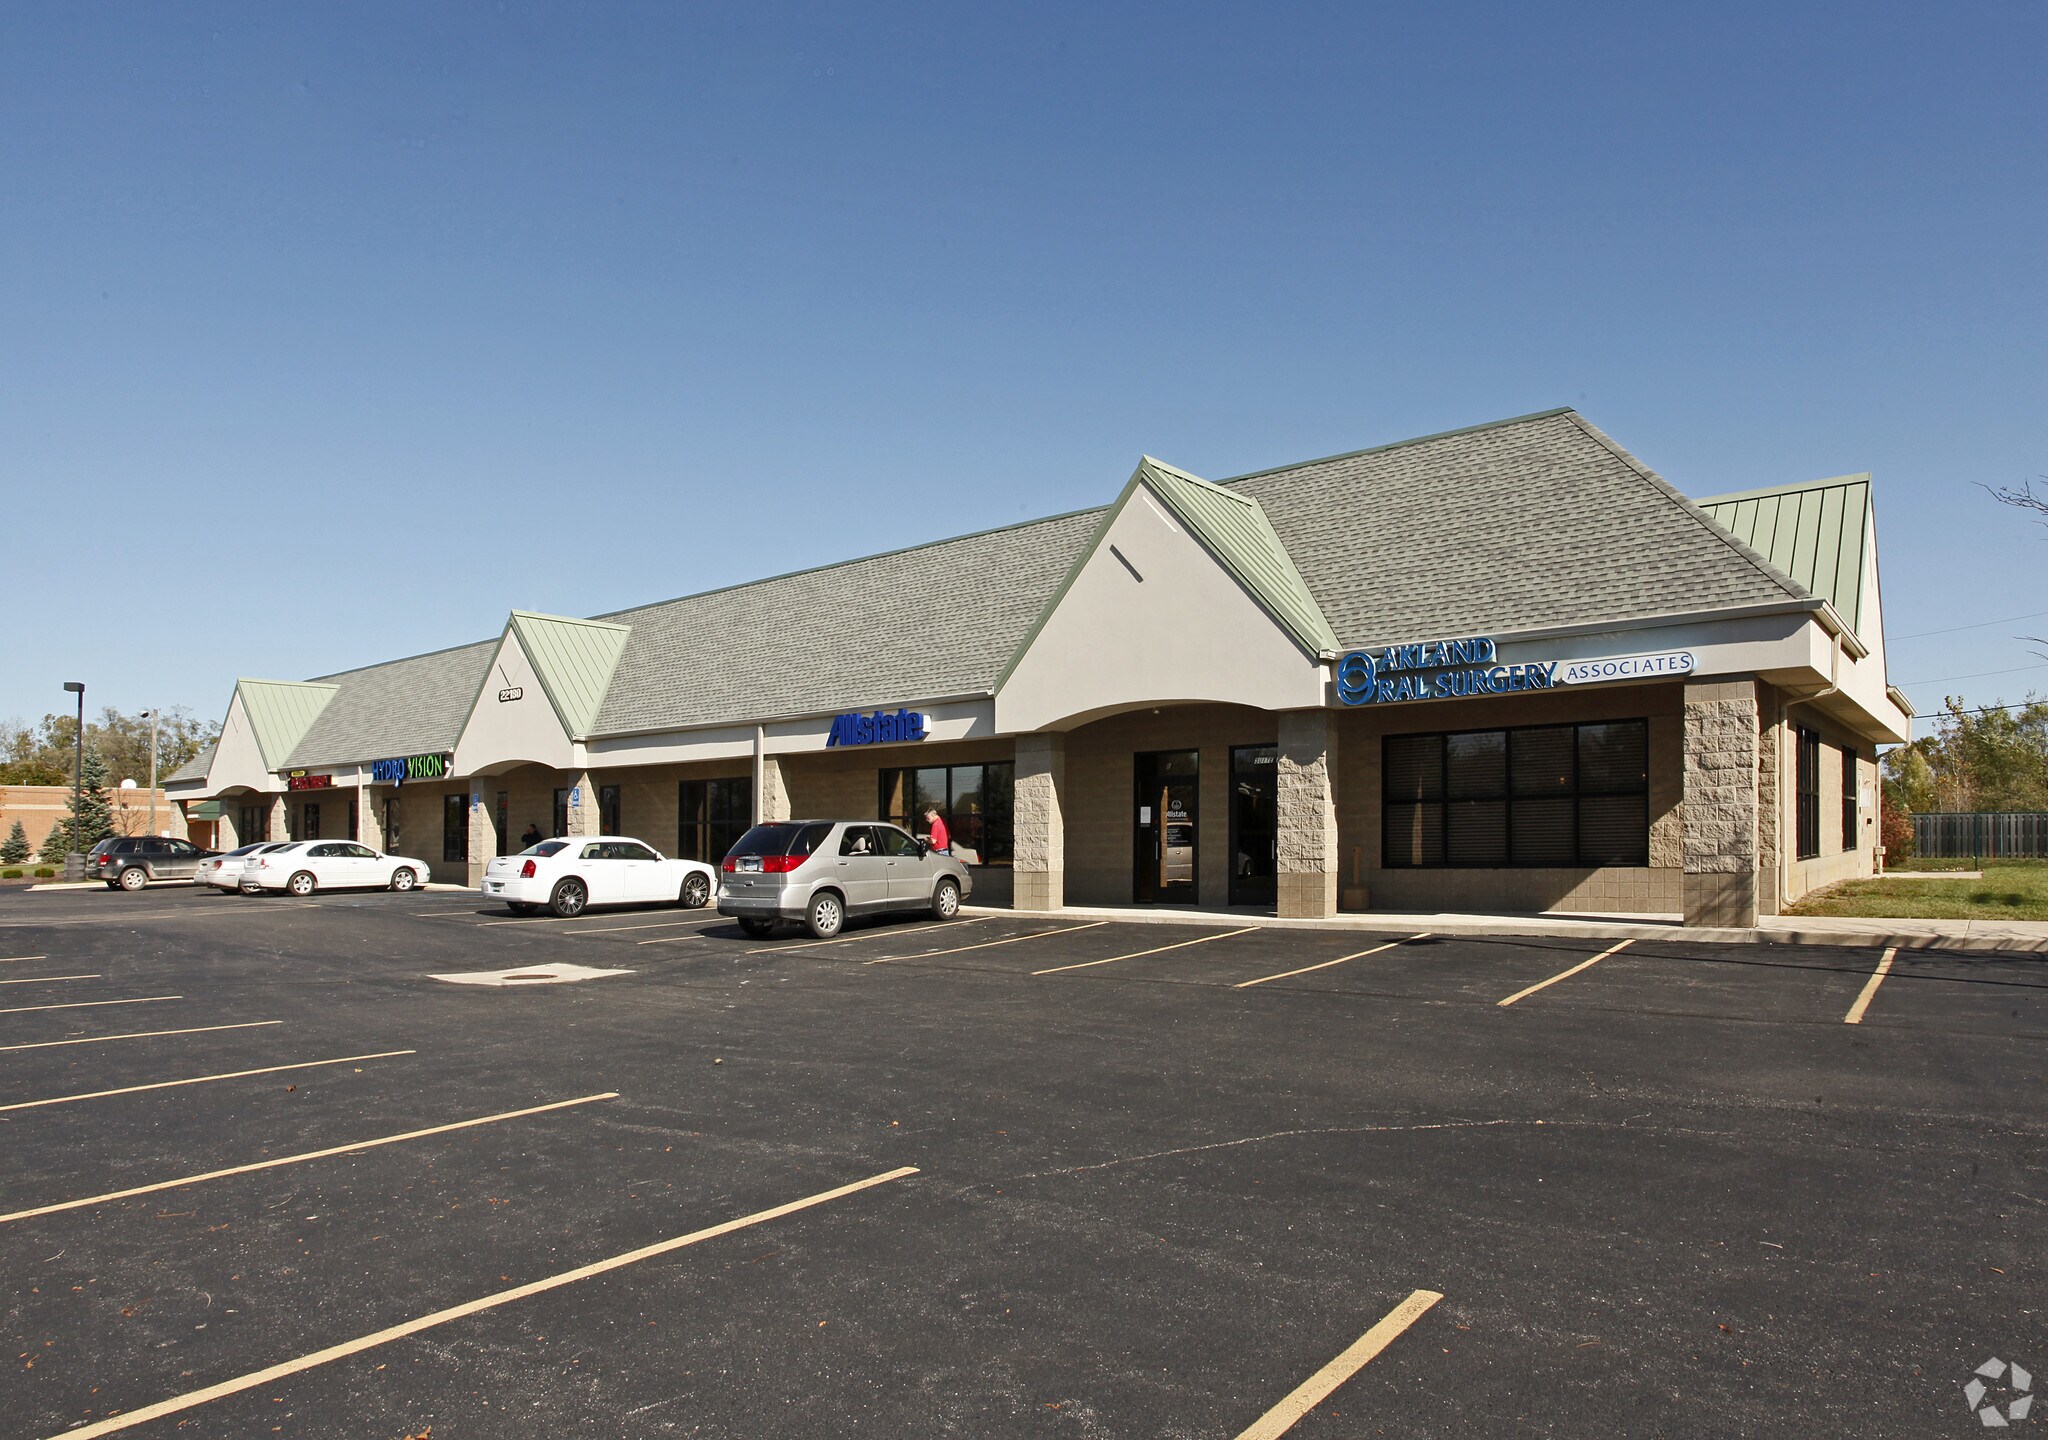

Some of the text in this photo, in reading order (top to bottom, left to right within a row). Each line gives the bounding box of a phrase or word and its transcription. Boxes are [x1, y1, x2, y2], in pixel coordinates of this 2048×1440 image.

[1435, 661, 1558, 698] SURGERY
[1567, 655, 1690, 680] ASSOCIATES
[826, 708, 924, 747] Allstate
[372, 754, 443, 787] HYDRO VISION
